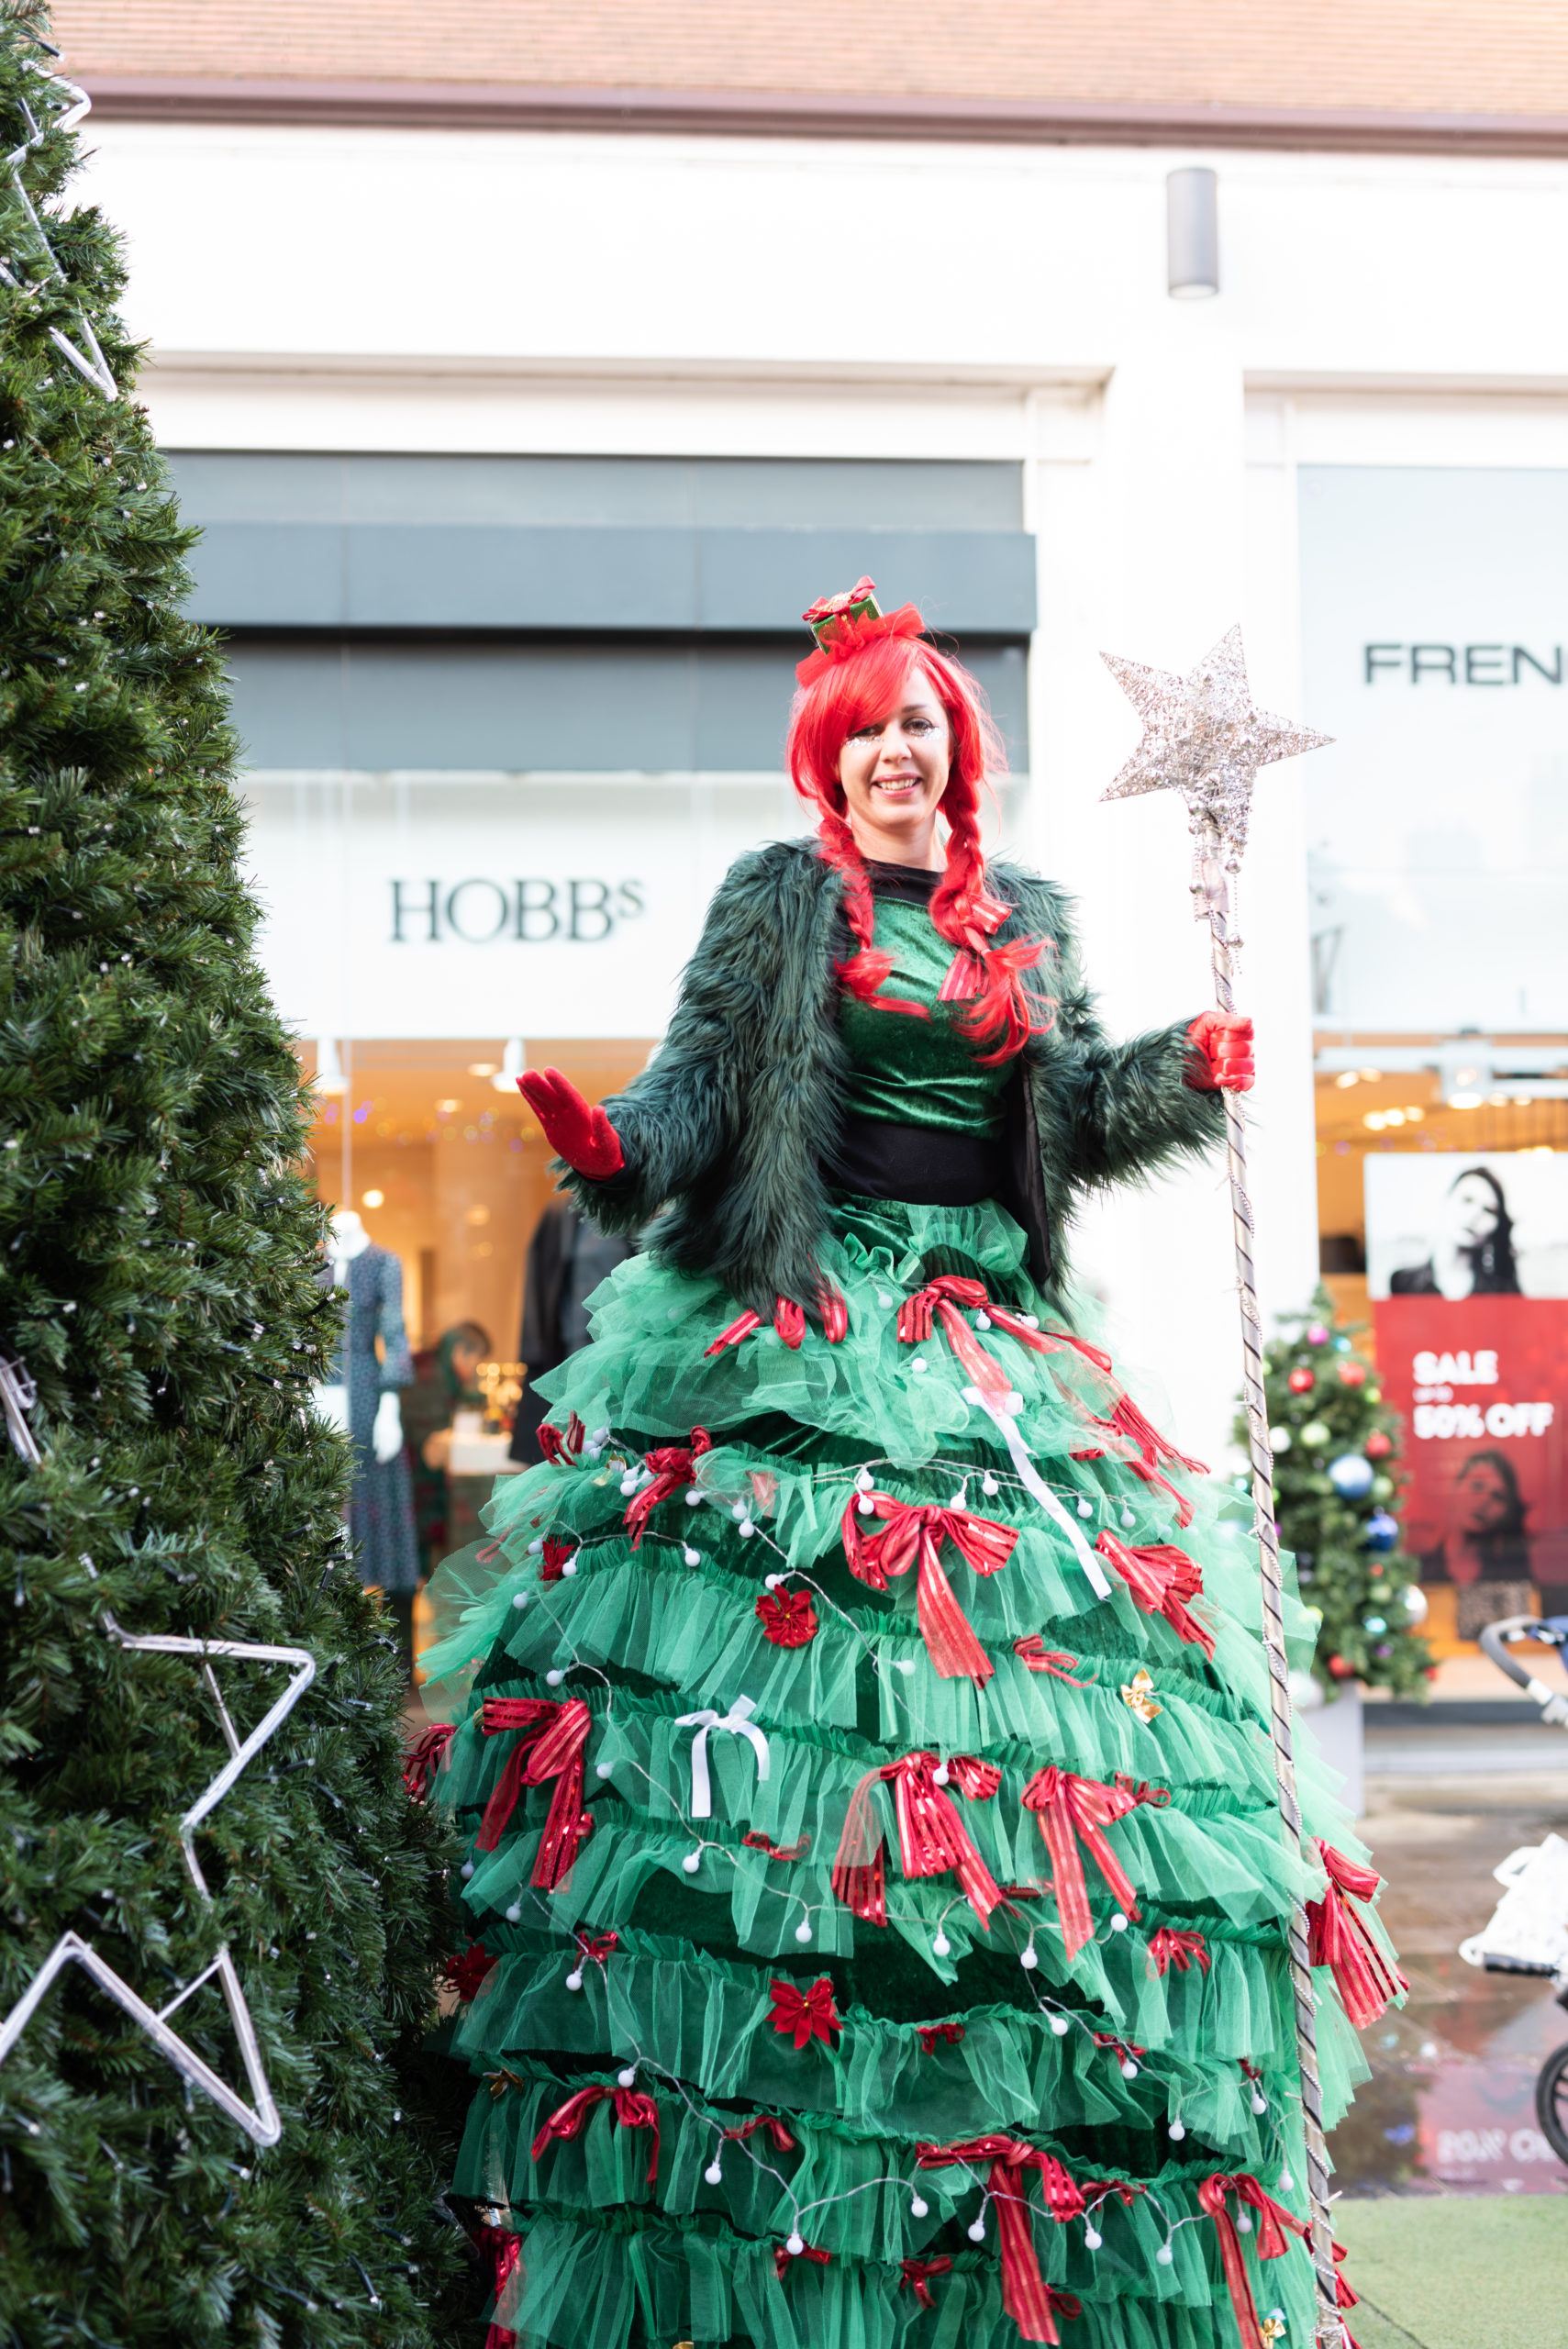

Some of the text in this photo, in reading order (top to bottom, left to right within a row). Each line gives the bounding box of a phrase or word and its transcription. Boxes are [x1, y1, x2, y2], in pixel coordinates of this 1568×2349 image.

[1364, 643, 1565, 685] FREN
[389, 877, 646, 944] HOBBS
[1413, 1350, 1499, 1386] SALE
[1485, 1402, 1554, 1438] OFF
